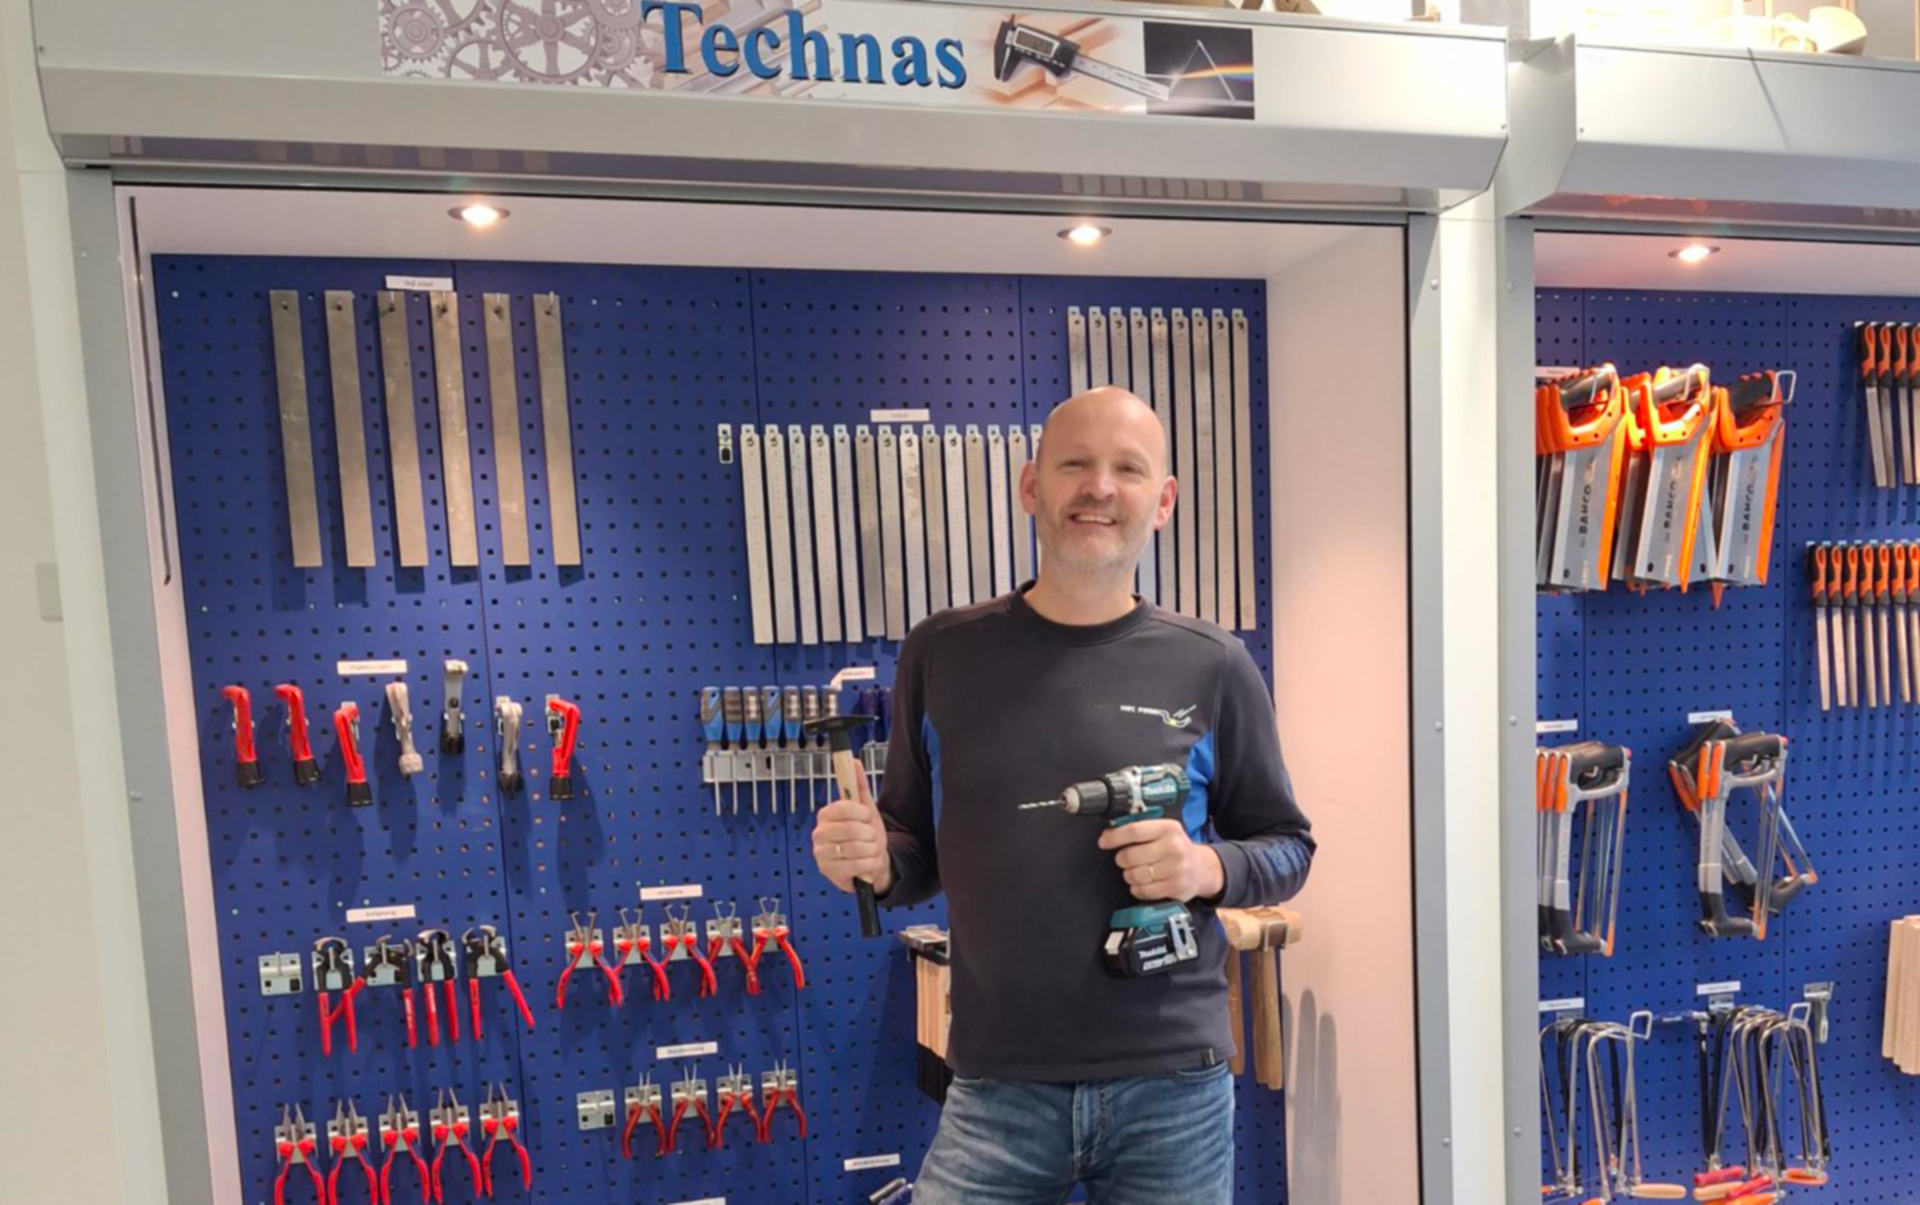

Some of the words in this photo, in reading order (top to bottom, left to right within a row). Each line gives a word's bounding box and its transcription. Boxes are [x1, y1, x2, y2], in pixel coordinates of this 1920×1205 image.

[641, 1, 967, 90] Technas
[1578, 484, 1591, 534] BAHCO
[1663, 480, 1676, 529] BAHCO
[1742, 484, 1755, 532] BAHCO
